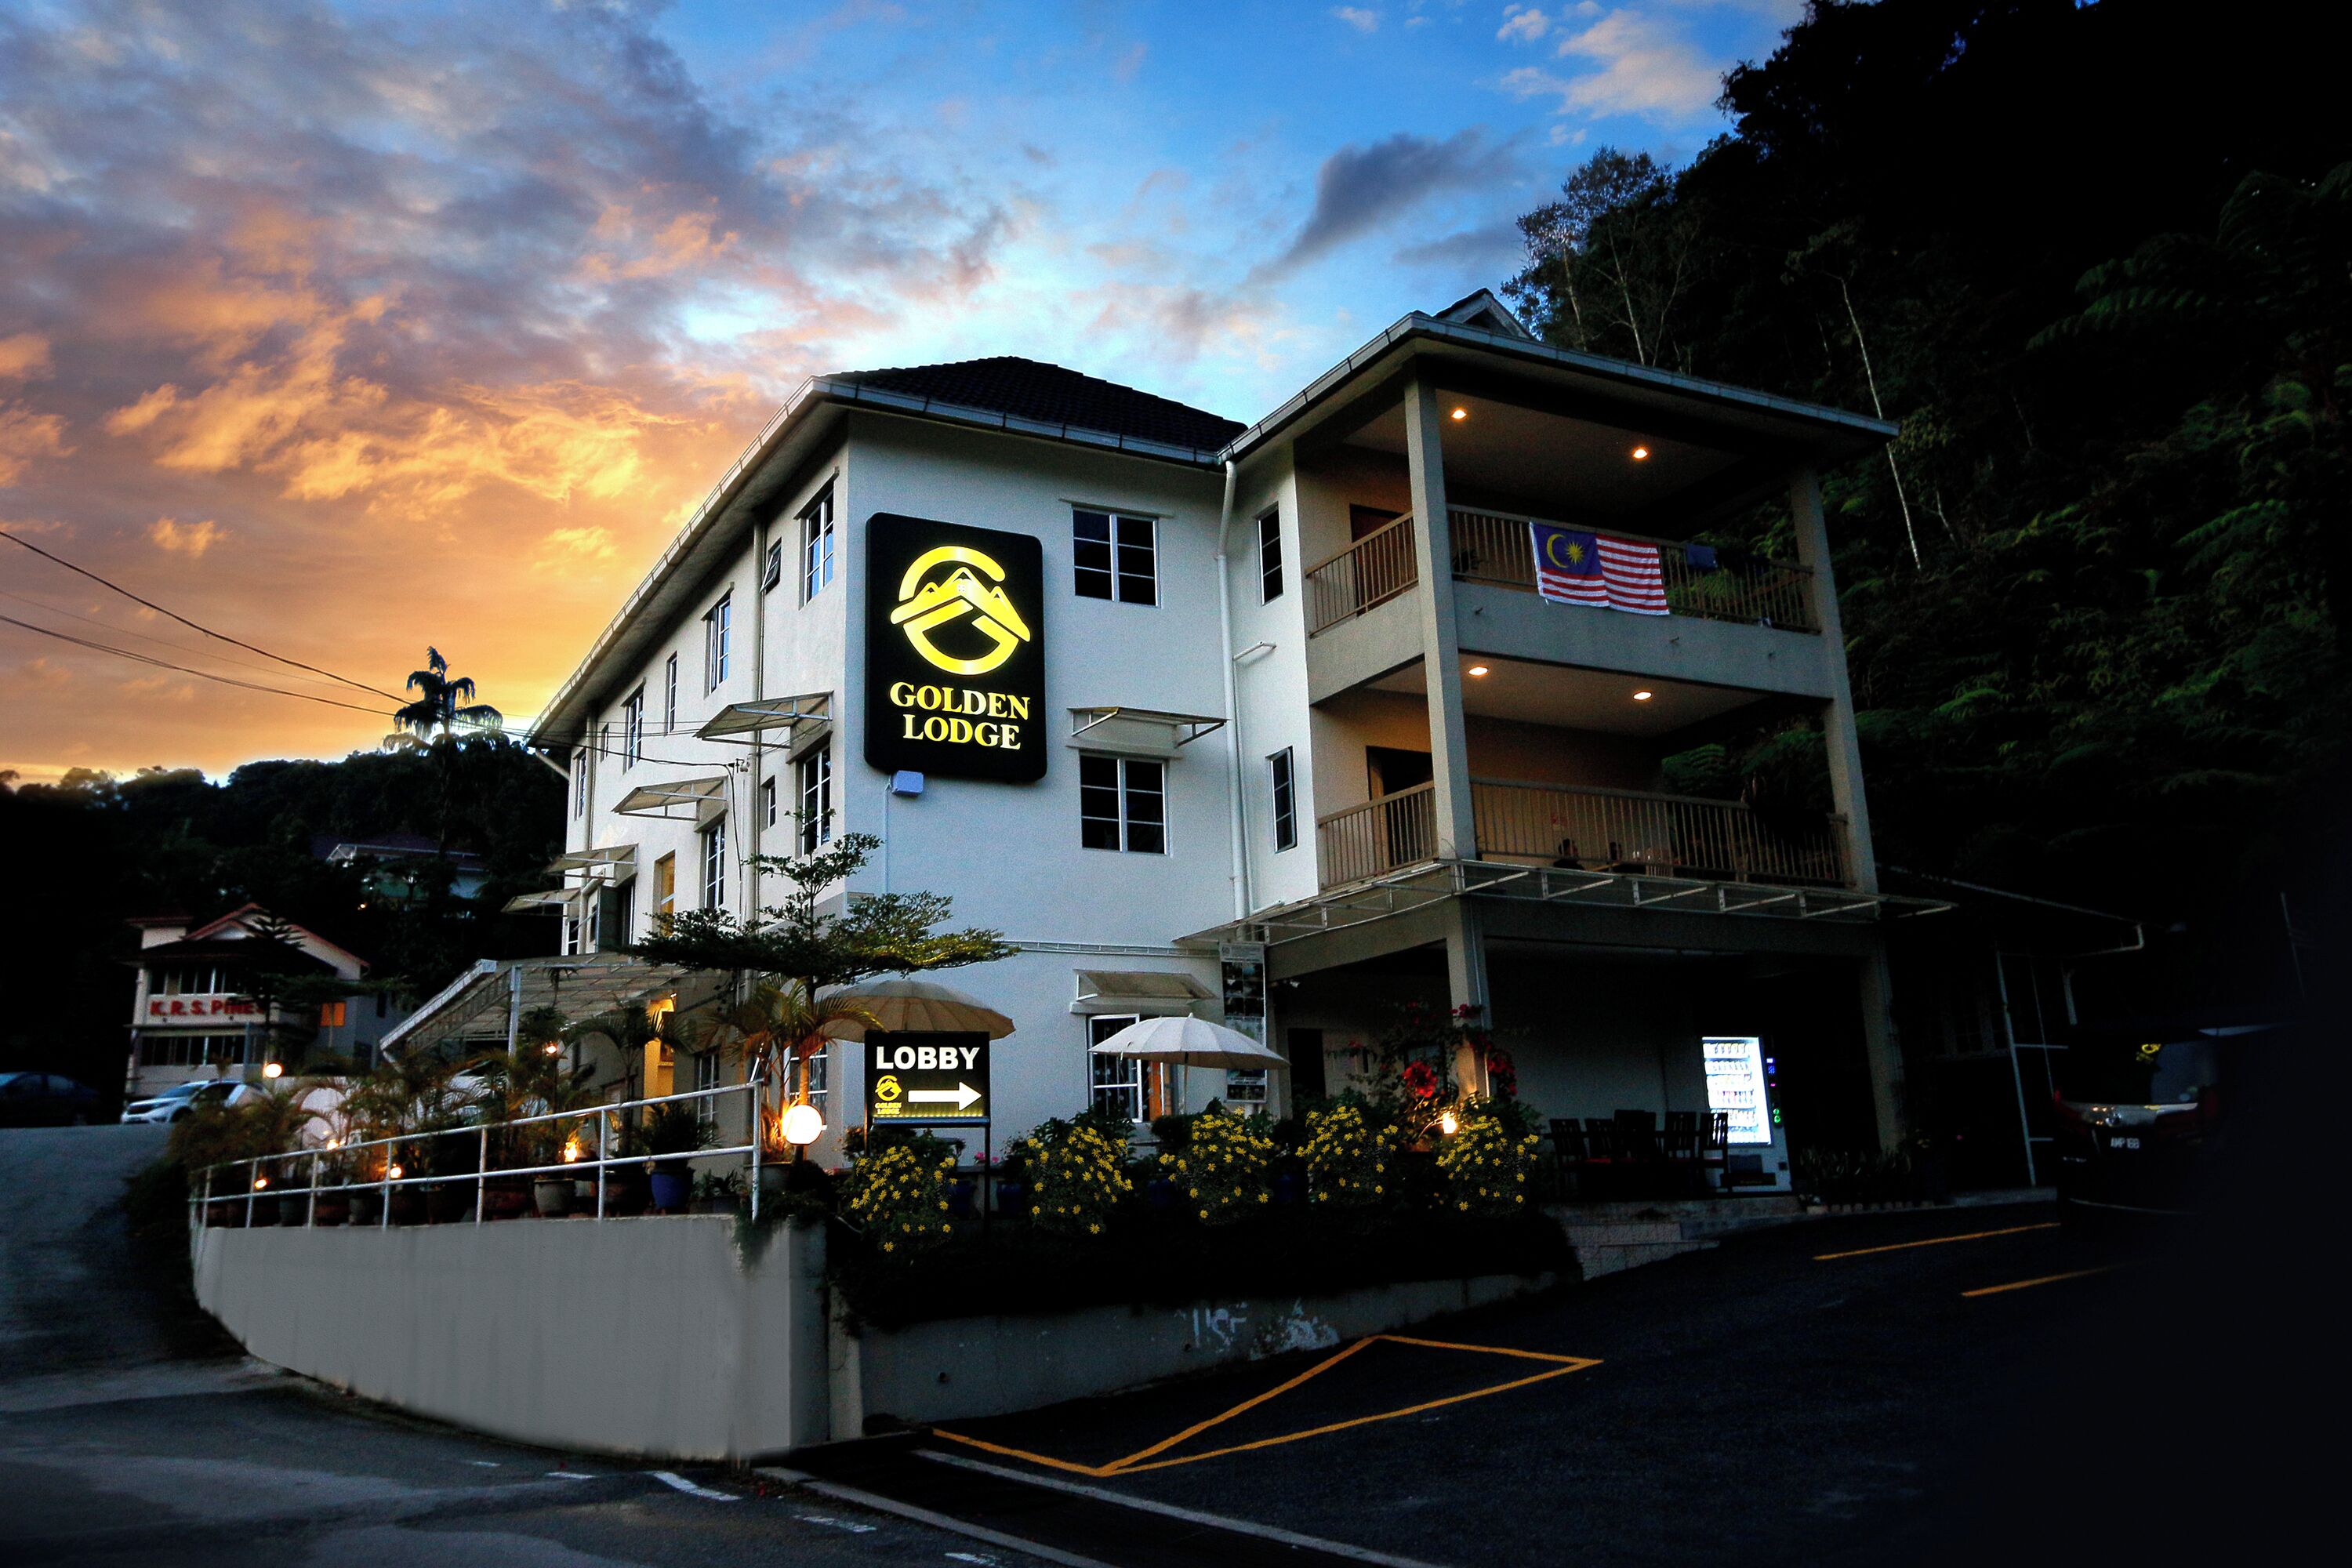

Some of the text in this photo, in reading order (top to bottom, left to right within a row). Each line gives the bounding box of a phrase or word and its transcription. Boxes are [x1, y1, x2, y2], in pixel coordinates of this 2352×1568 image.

[890, 682, 1031, 720] GOLDEN
[903, 714, 1021, 750] LODGE
[876, 1046, 981, 1070] LOBBY
